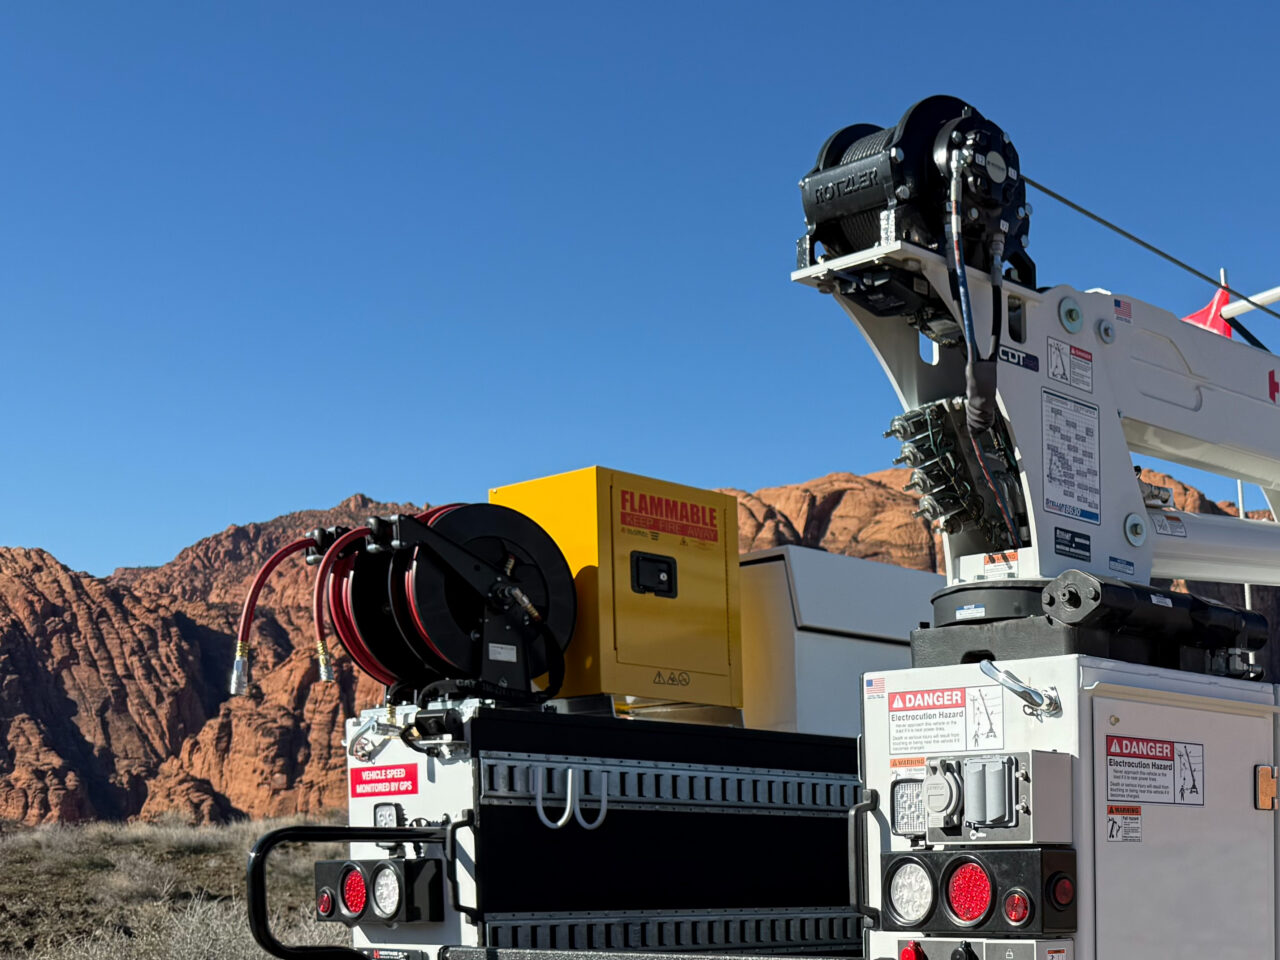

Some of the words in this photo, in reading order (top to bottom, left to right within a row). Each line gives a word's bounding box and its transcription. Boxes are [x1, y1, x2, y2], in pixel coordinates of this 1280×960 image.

[620, 489, 718, 529] FLAMMABLE
[626, 514, 654, 529] KEEP
[659, 521, 681, 534] FIRE
[687, 526, 716, 540] AWAY
[905, 690, 962, 708] DANGER
[891, 712, 937, 722] Electrocution
[939, 710, 964, 719] Hazard
[1122, 740, 1171, 757] DANGER
[1109, 758, 1150, 769] Electrocution
[1152, 761, 1173, 771] Hazard
[361, 769, 386, 780] VEHICLE
[386, 768, 406, 779] SPEED
[356, 782, 390, 794] MONITORED
[390, 781, 399, 792] BY
[399, 780, 413, 791] GPS
